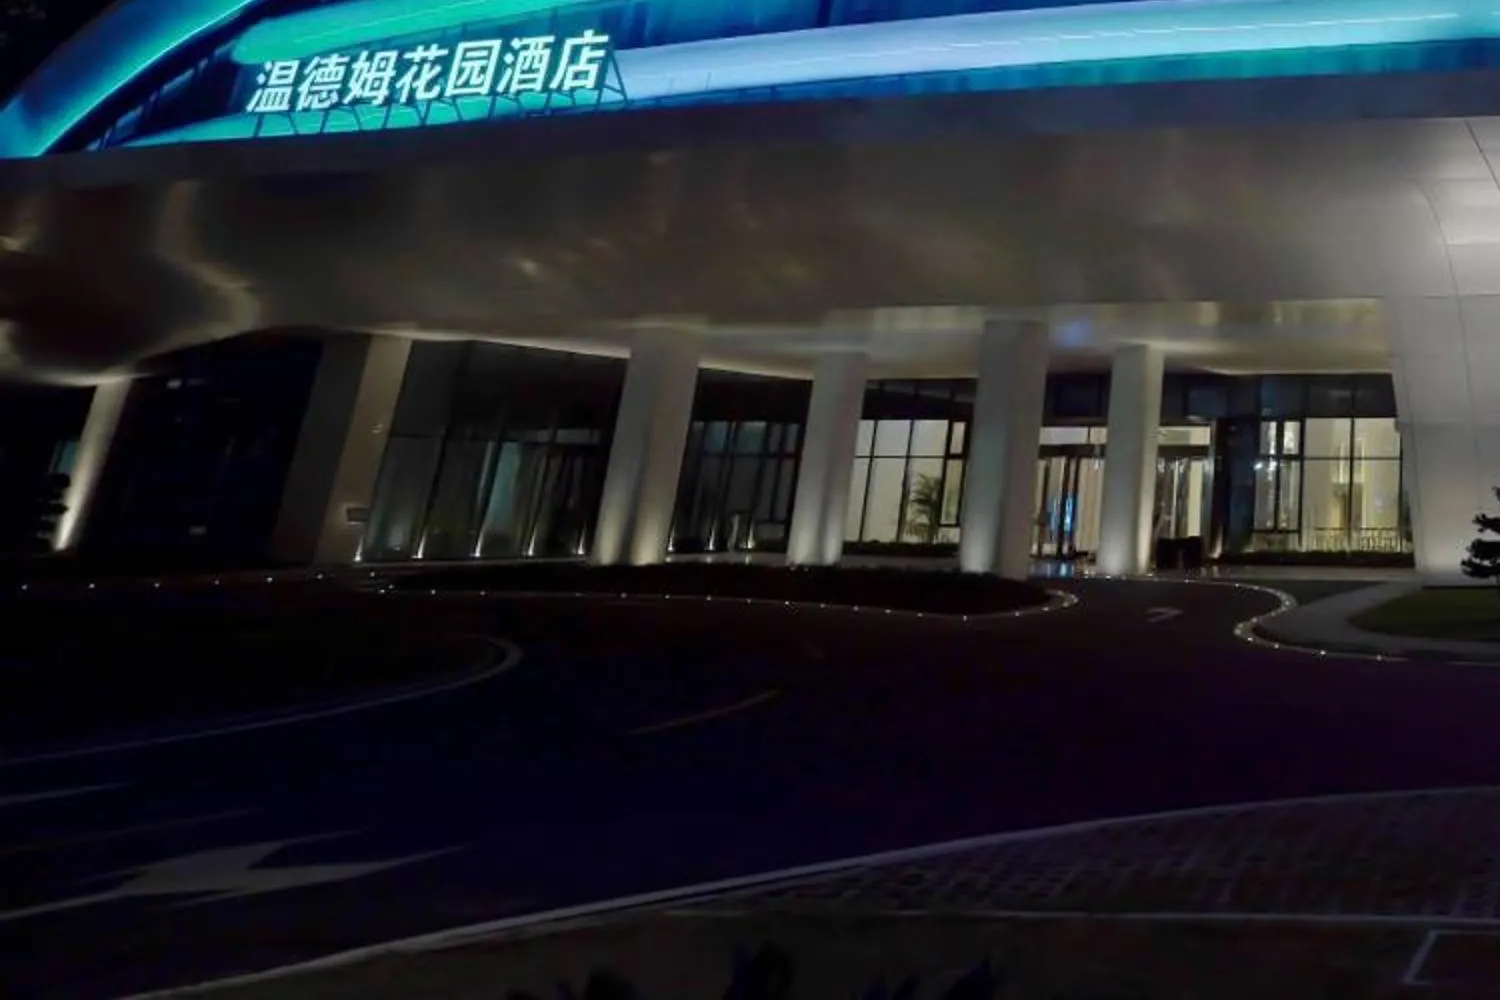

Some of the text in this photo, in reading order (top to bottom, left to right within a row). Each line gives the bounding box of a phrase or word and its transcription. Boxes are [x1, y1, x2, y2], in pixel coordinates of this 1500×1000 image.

[246, 29, 610, 114] 温德姆花园酒店
